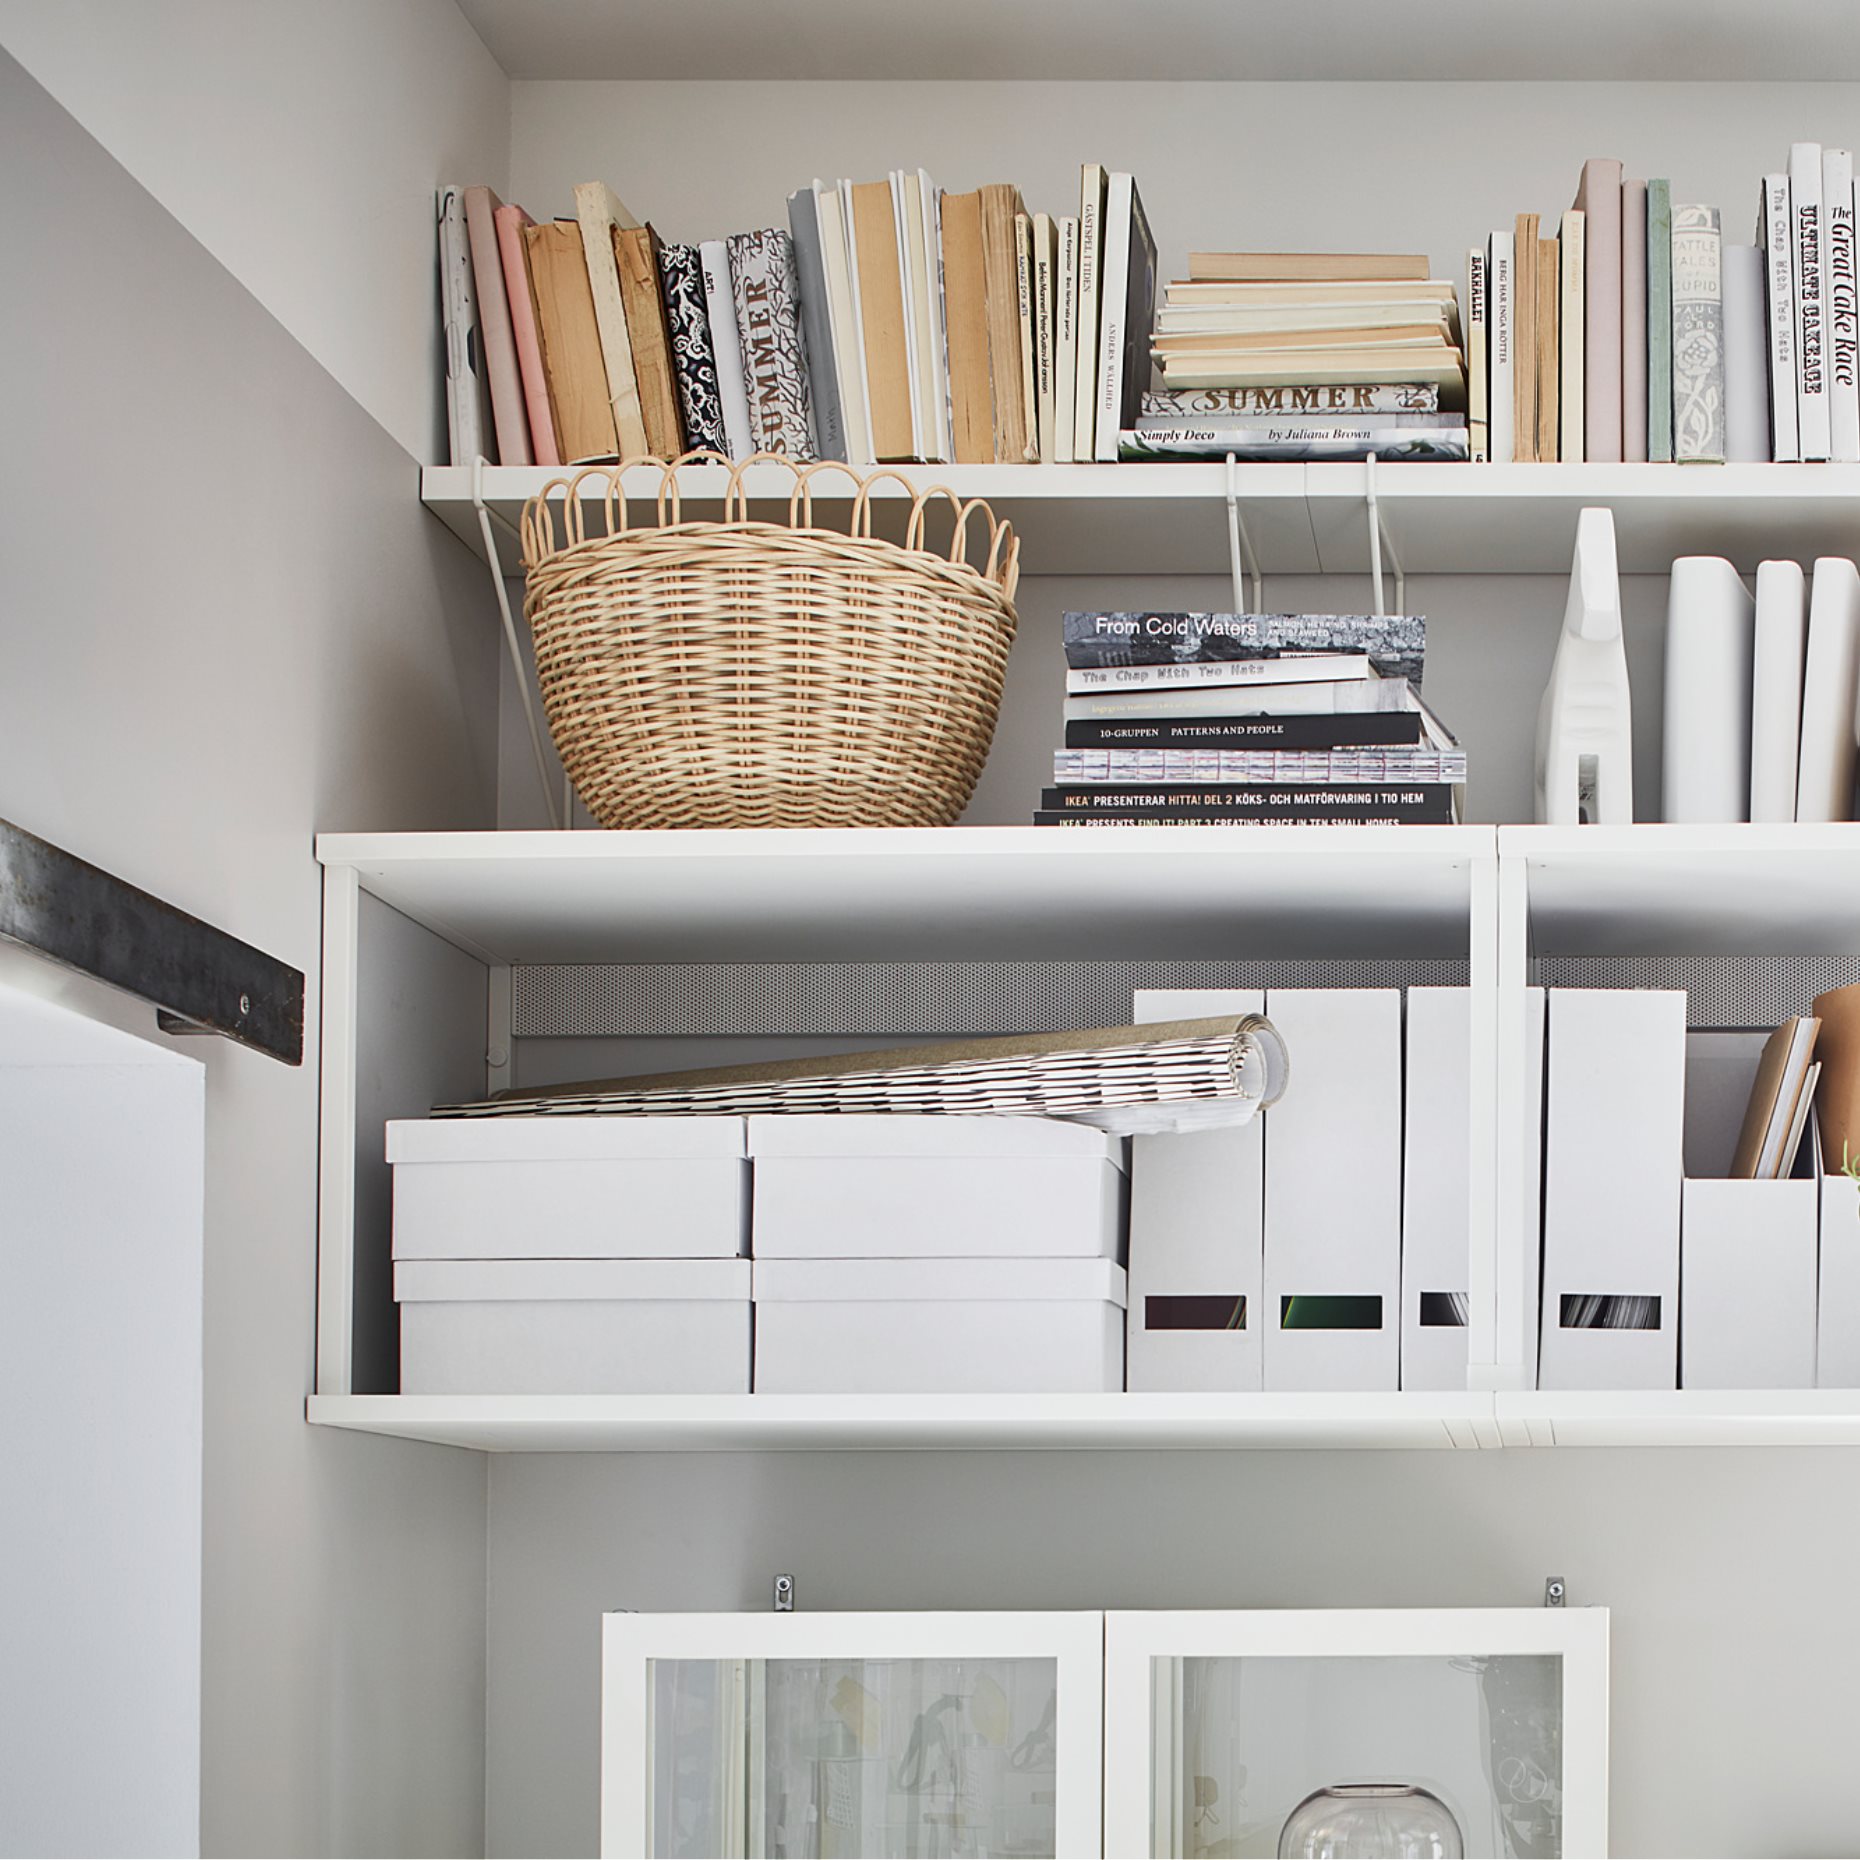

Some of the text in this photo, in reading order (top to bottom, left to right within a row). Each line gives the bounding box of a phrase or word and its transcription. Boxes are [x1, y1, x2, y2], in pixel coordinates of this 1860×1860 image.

[1799, 204, 1819, 301] ULTIMATE
[1082, 261, 1092, 293] TIDEN
[1499, 260, 1507, 281] BERG
[1499, 284, 1507, 303] HAR
[1831, 207, 1857, 386] The Great Cake Race
[1499, 305, 1507, 328] INGA
[1108, 323, 1117, 360] ANDERS
[744, 276, 787, 454] SUMMER
[1203, 387, 1377, 410] SUMMER
[1139, 429, 1215, 442] Simply Deco
[1268, 429, 1371, 442] by Juliana Brown
[1095, 617, 1258, 636] From Cold Waters
[1082, 664, 1265, 683] The Chap With Two Hats
[1100, 724, 1284, 738] 10-GRUPPEN PATTERNS AND PEOPLE
[1094, 795, 1166, 806] PRESENTERAR
[1168, 794, 1201, 805] HITTA!
[1204, 794, 1223, 805] DEL
[1225, 794, 1233, 805] 2
[1235, 792, 1267, 805] KÖKS-
[1269, 794, 1291, 805] OCH
[1293, 792, 1372, 805] MATFÖRVARING
[1374, 793, 1379, 804] I
[1381, 793, 1398, 804] TIO
[1400, 793, 1424, 804] HEM
[1086, 818, 1135, 826] PRESENTS
